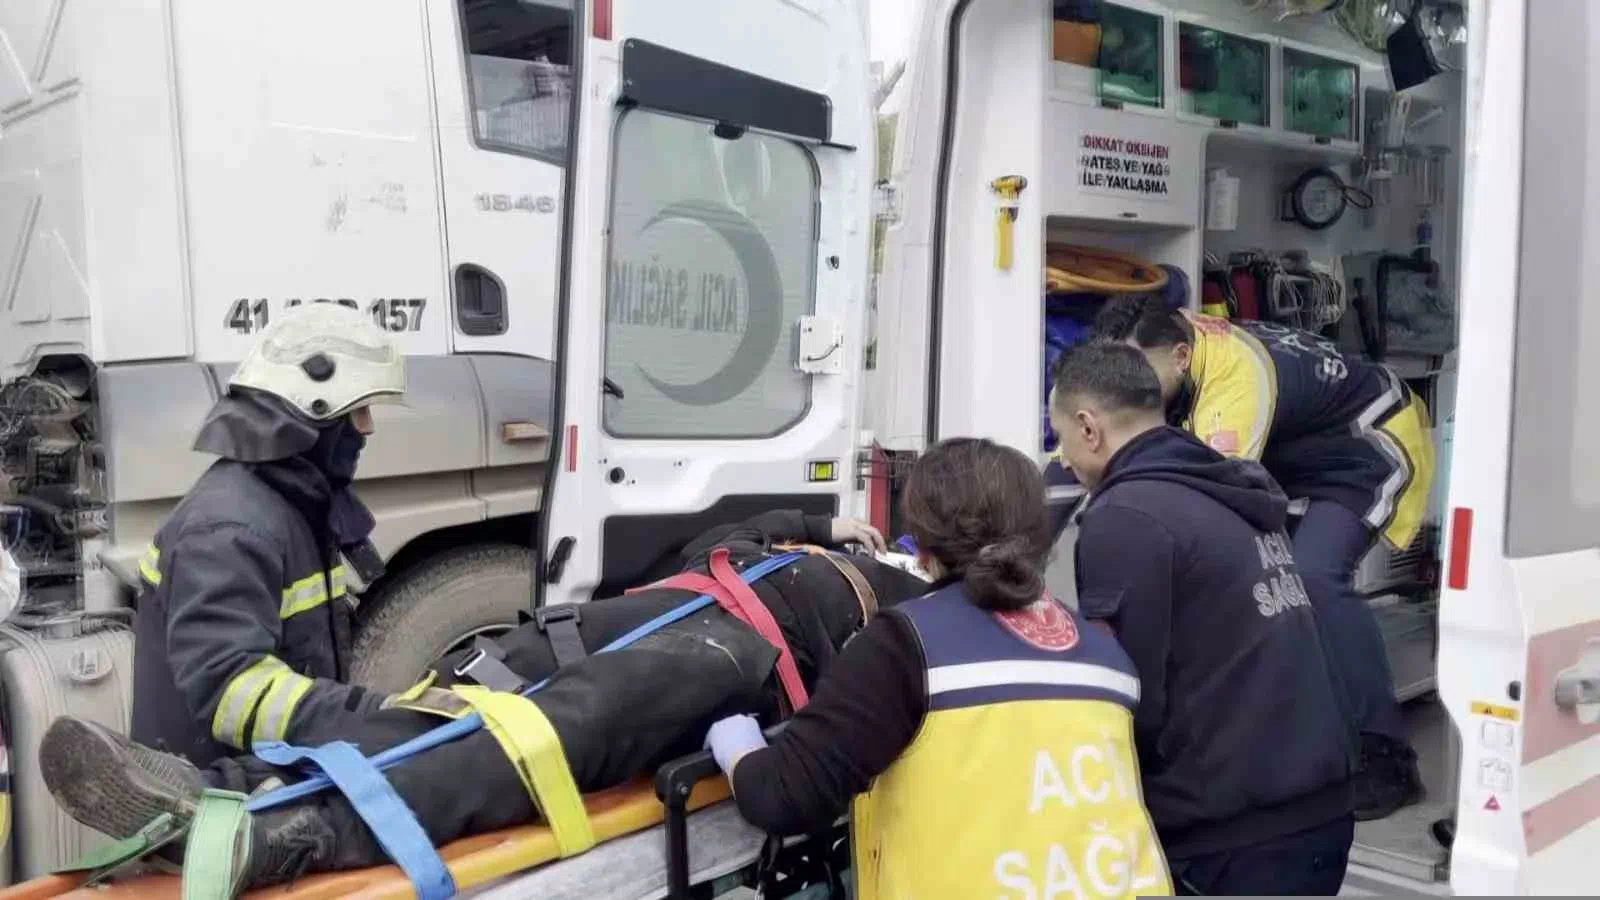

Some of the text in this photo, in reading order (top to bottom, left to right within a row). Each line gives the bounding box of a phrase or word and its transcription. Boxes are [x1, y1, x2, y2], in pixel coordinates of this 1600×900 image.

[1123, 159, 1138, 173] VE
[224, 298, 427, 335] 41 157
